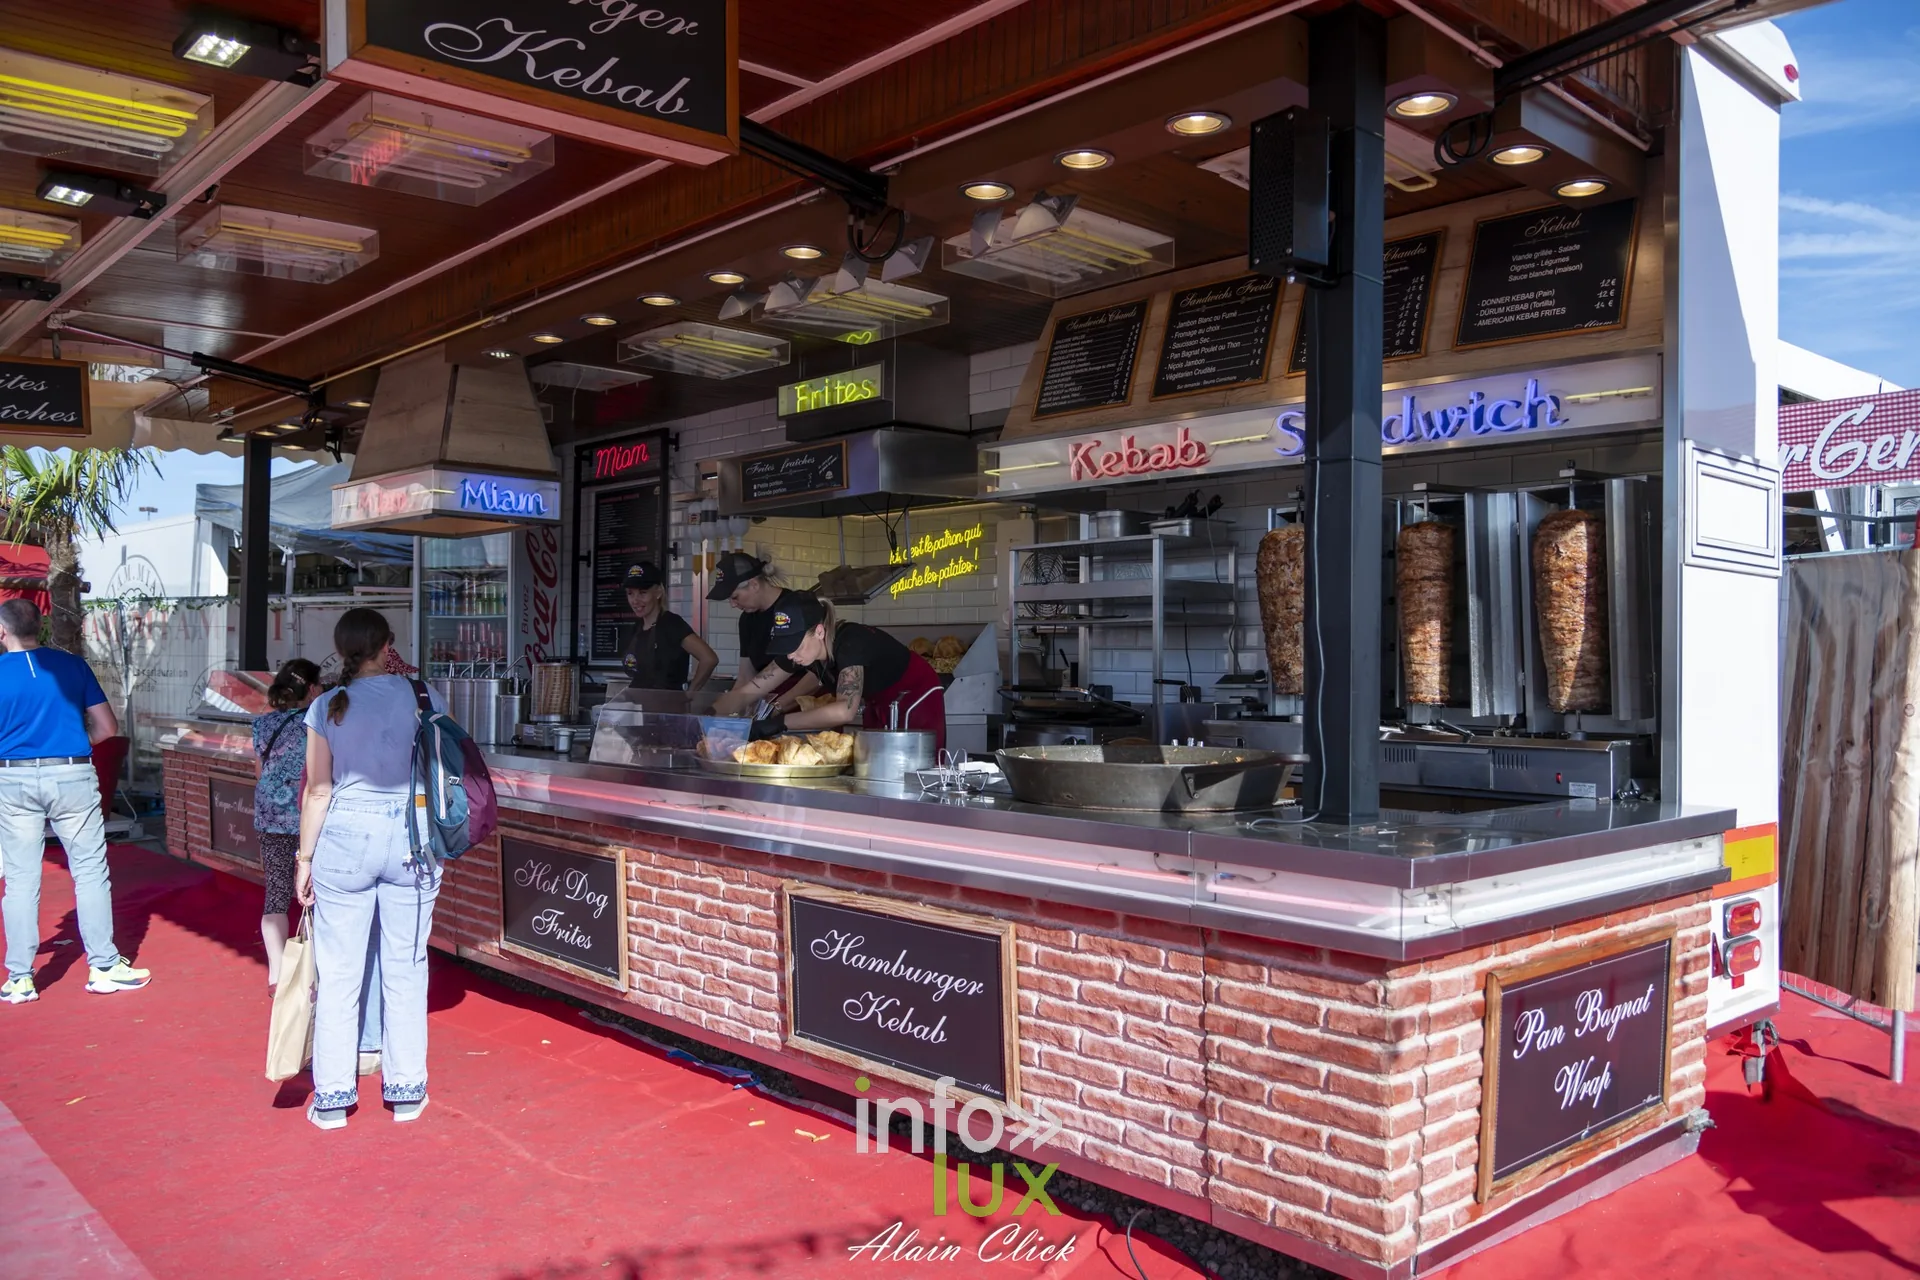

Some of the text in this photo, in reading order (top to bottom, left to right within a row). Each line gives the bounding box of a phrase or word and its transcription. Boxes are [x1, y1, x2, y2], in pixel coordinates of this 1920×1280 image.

[424, 18, 690, 114] Kebab
[1525, 213, 1582, 237] Kebab
[1510, 263, 1535, 272] Oignons
[1541, 256, 1569, 268] Légumes
[1512, 254, 1533, 262] Viande
[1534, 250, 1553, 260] grillée
[1558, 243, 1580, 253] Salade
[1508, 263, 1582, 282] Sauce blanche (maison)
[1180, 277, 1274, 308] Sandwichs Froids
[1481, 296, 1510, 307] DONNER
[1511, 292, 1534, 302] KEBAB
[1536, 289, 1555, 299] (Pain)
[1505, 303, 1529, 312] KEBAB
[1174, 328, 1197, 339] Fromage
[1206, 325, 1220, 333] choix
[1177, 319, 1197, 329] Jambon
[1198, 316, 1213, 325] Blanc
[1222, 311, 1237, 320] Fumé
[1477, 314, 1515, 327] AMERICAIN
[1517, 311, 1539, 322] KEBAB
[1541, 307, 1566, 318] FRITES
[1172, 339, 1198, 349] Saucisson
[1200, 336, 1210, 344] Sec
[1181, 347, 1200, 358] Bagnat
[1201, 345, 1218, 354] Poulet
[1227, 340, 1240, 349] Thon
[1168, 362, 1183, 371] Niçois
[1184, 358, 1205, 367] Jambon
[1194, 366, 1216, 376] Crudités
[795, 378, 873, 413] Frites
[1274, 378, 1568, 457] Sdwich
[595, 443, 650, 479] Miam
[745, 461, 775, 476] Frites
[780, 454, 816, 473] fraîches
[1069, 427, 1211, 481] Kebab
[461, 478, 549, 515] Miam
[772, 487, 787, 496] portion
[933, 529, 963, 559] patron
[964, 523, 982, 548] qui
[938, 556, 974, 588] patates
[521, 584, 529, 635] Buvez
[514, 859, 608, 919] Hot Dog
[532, 908, 593, 949] Frites
[810, 929, 984, 1002] Hamburger
[843, 991, 947, 1044] Kebab
[1513, 984, 1655, 1059] Pan Bagnat
[1554, 1056, 1611, 1110] Wrap
